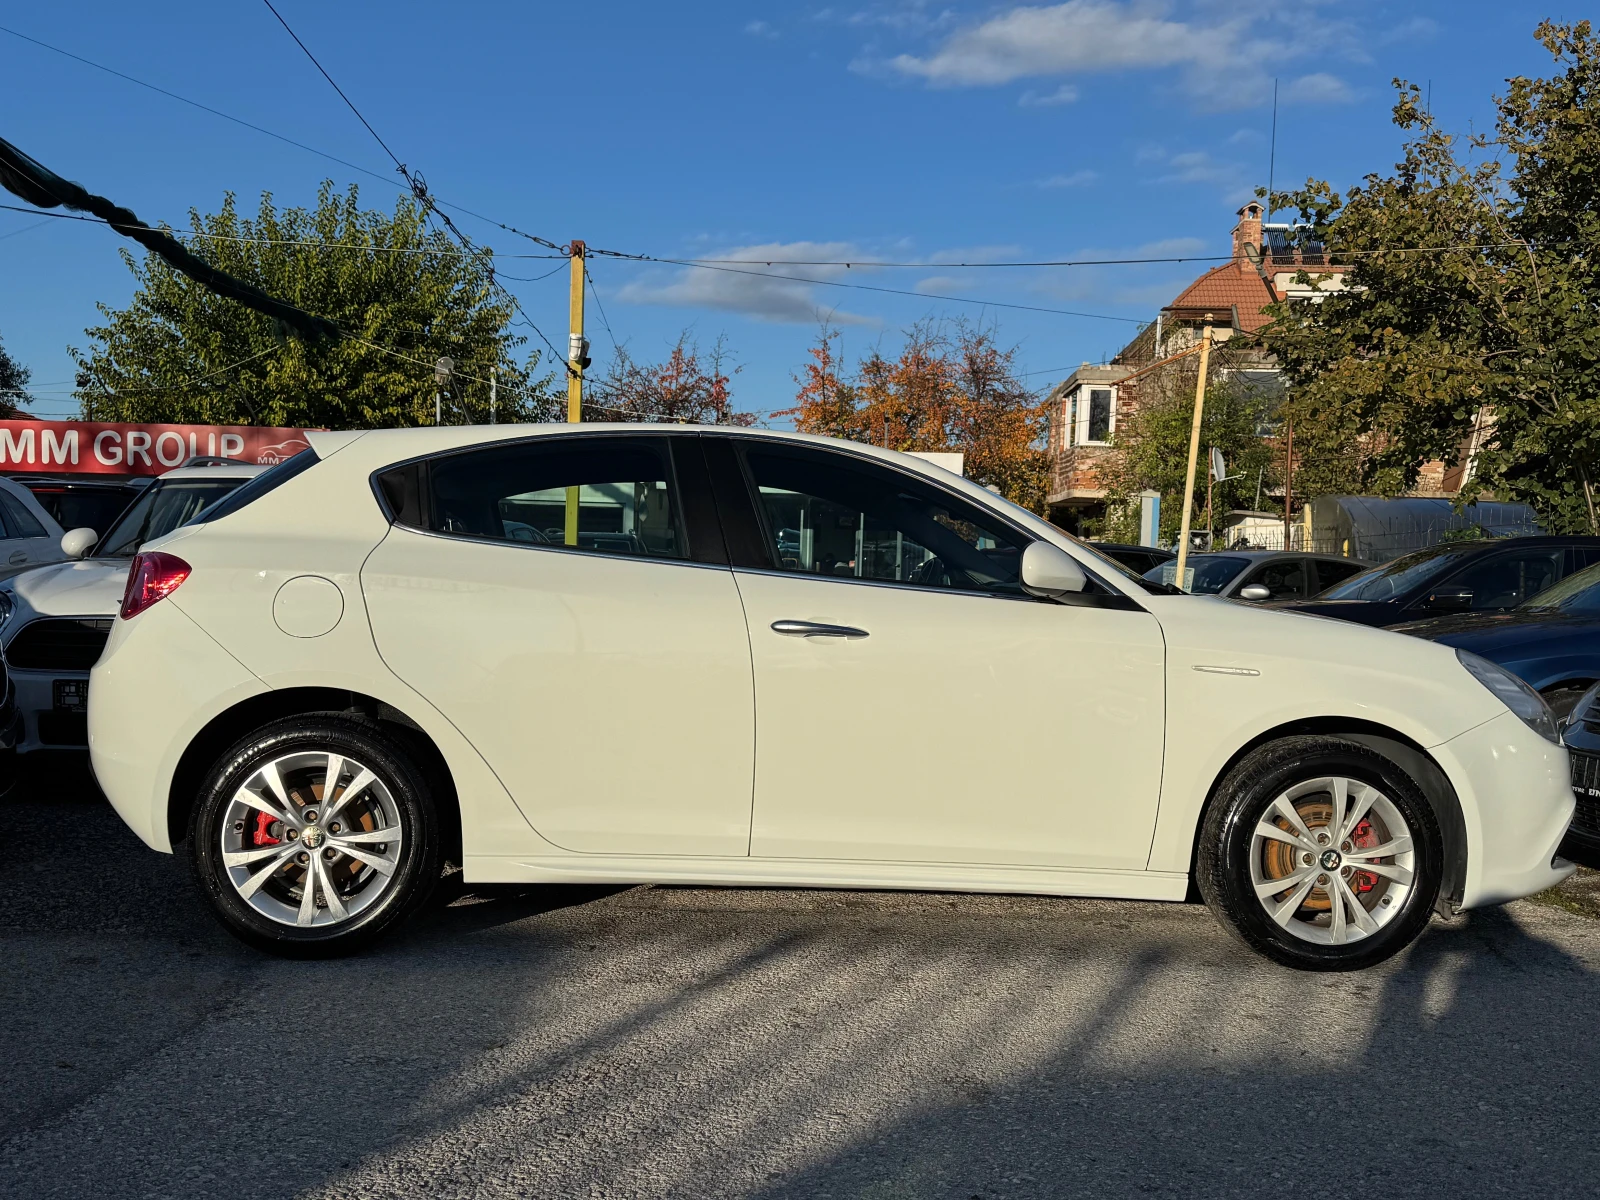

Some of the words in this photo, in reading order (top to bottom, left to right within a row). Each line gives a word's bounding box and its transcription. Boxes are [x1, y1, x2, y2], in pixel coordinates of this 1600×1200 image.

[0, 428, 79, 465] MM
[93, 429, 245, 468] GROUP
[257, 456, 279, 465] MM
